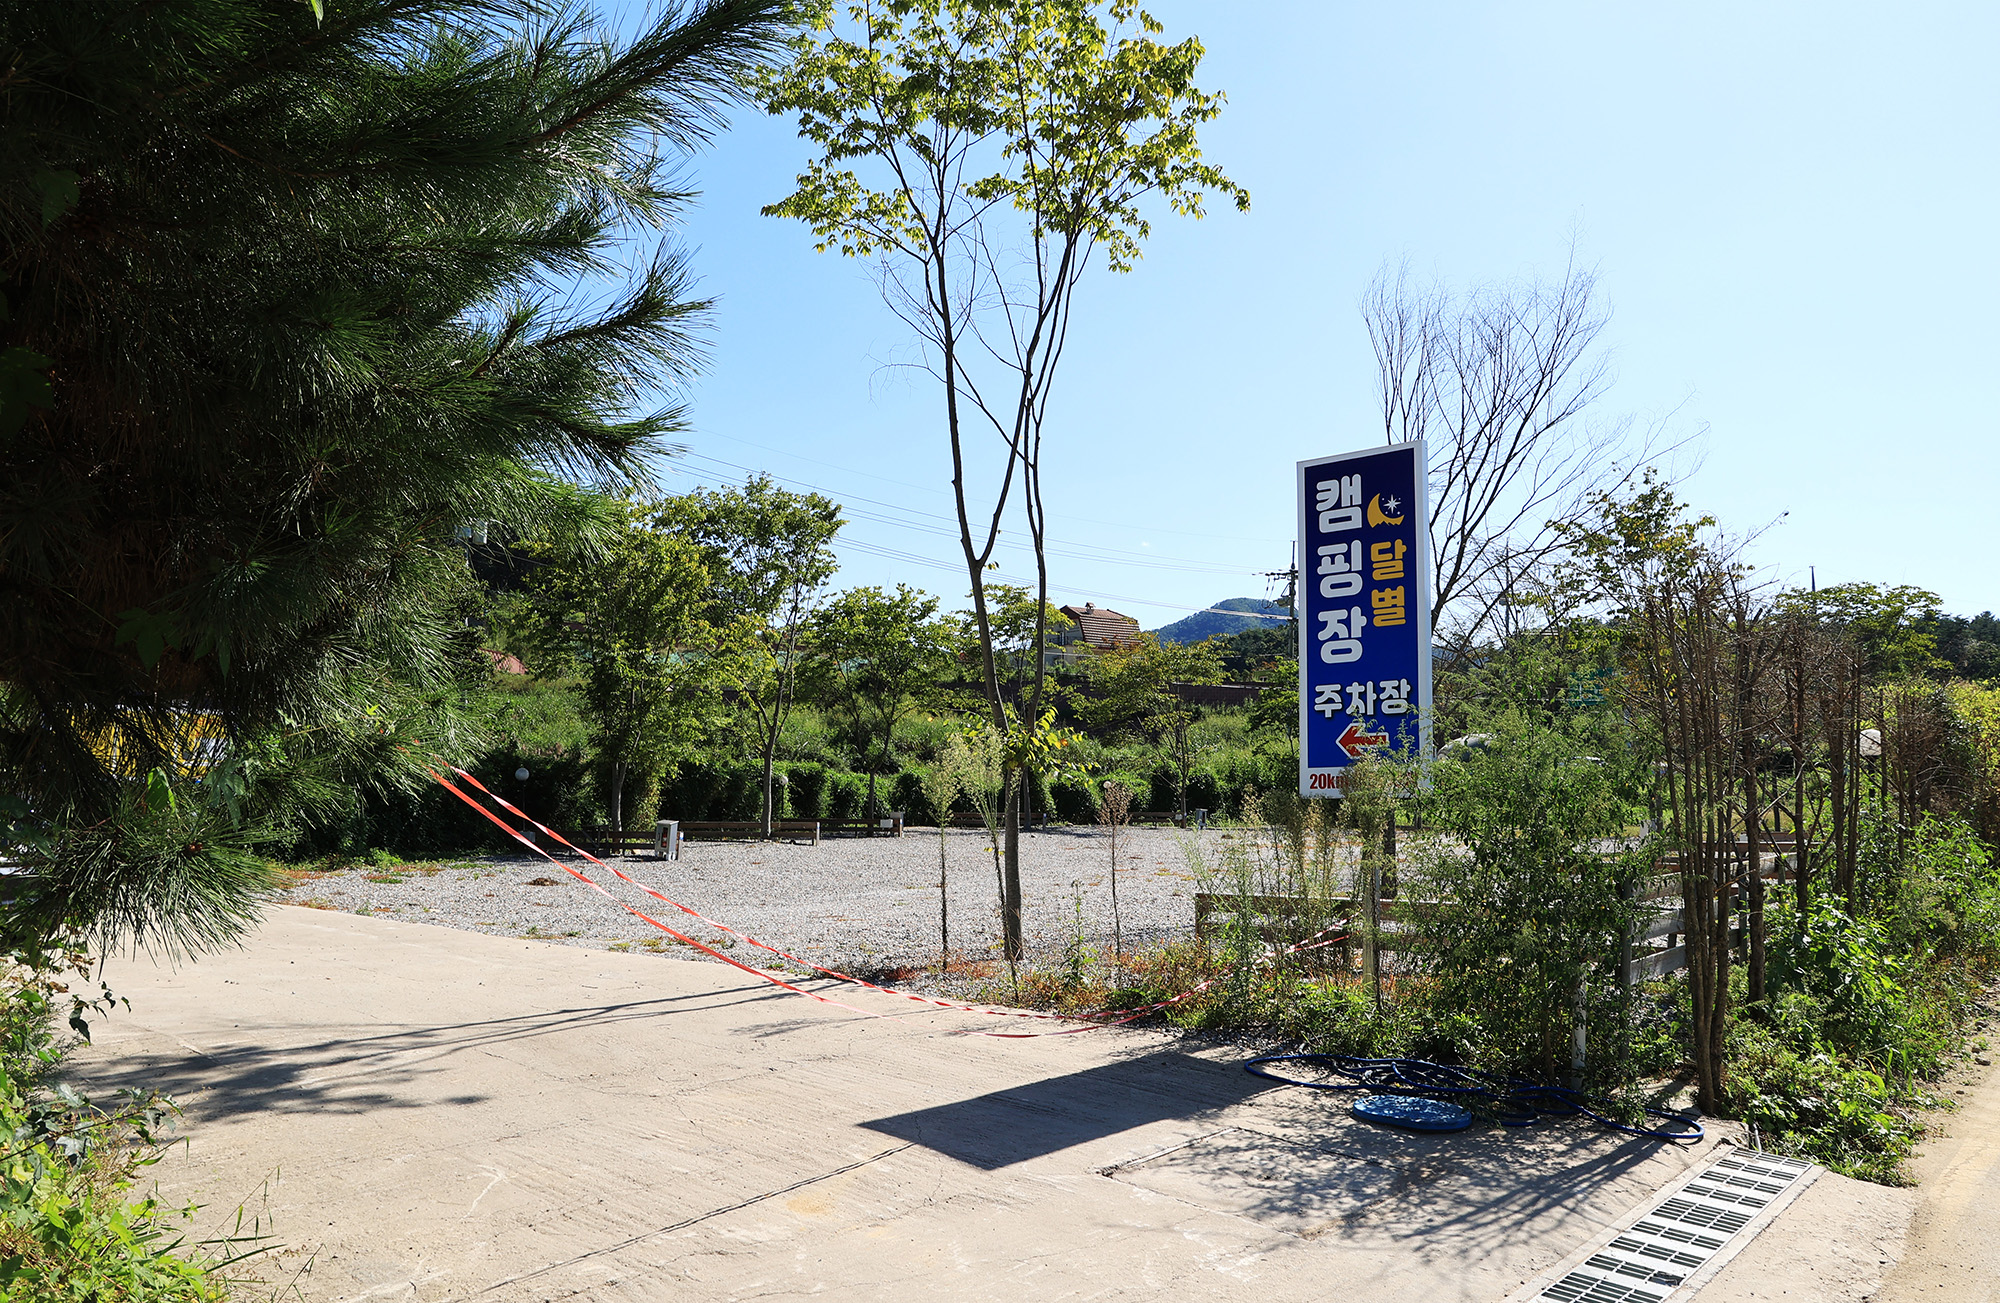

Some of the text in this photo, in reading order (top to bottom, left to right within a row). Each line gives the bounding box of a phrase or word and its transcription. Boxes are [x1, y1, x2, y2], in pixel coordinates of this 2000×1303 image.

[1316, 473, 1367, 664] 캠핑장
[1371, 538, 1407, 627] 달별
[1314, 678, 1411, 718] 주차장
